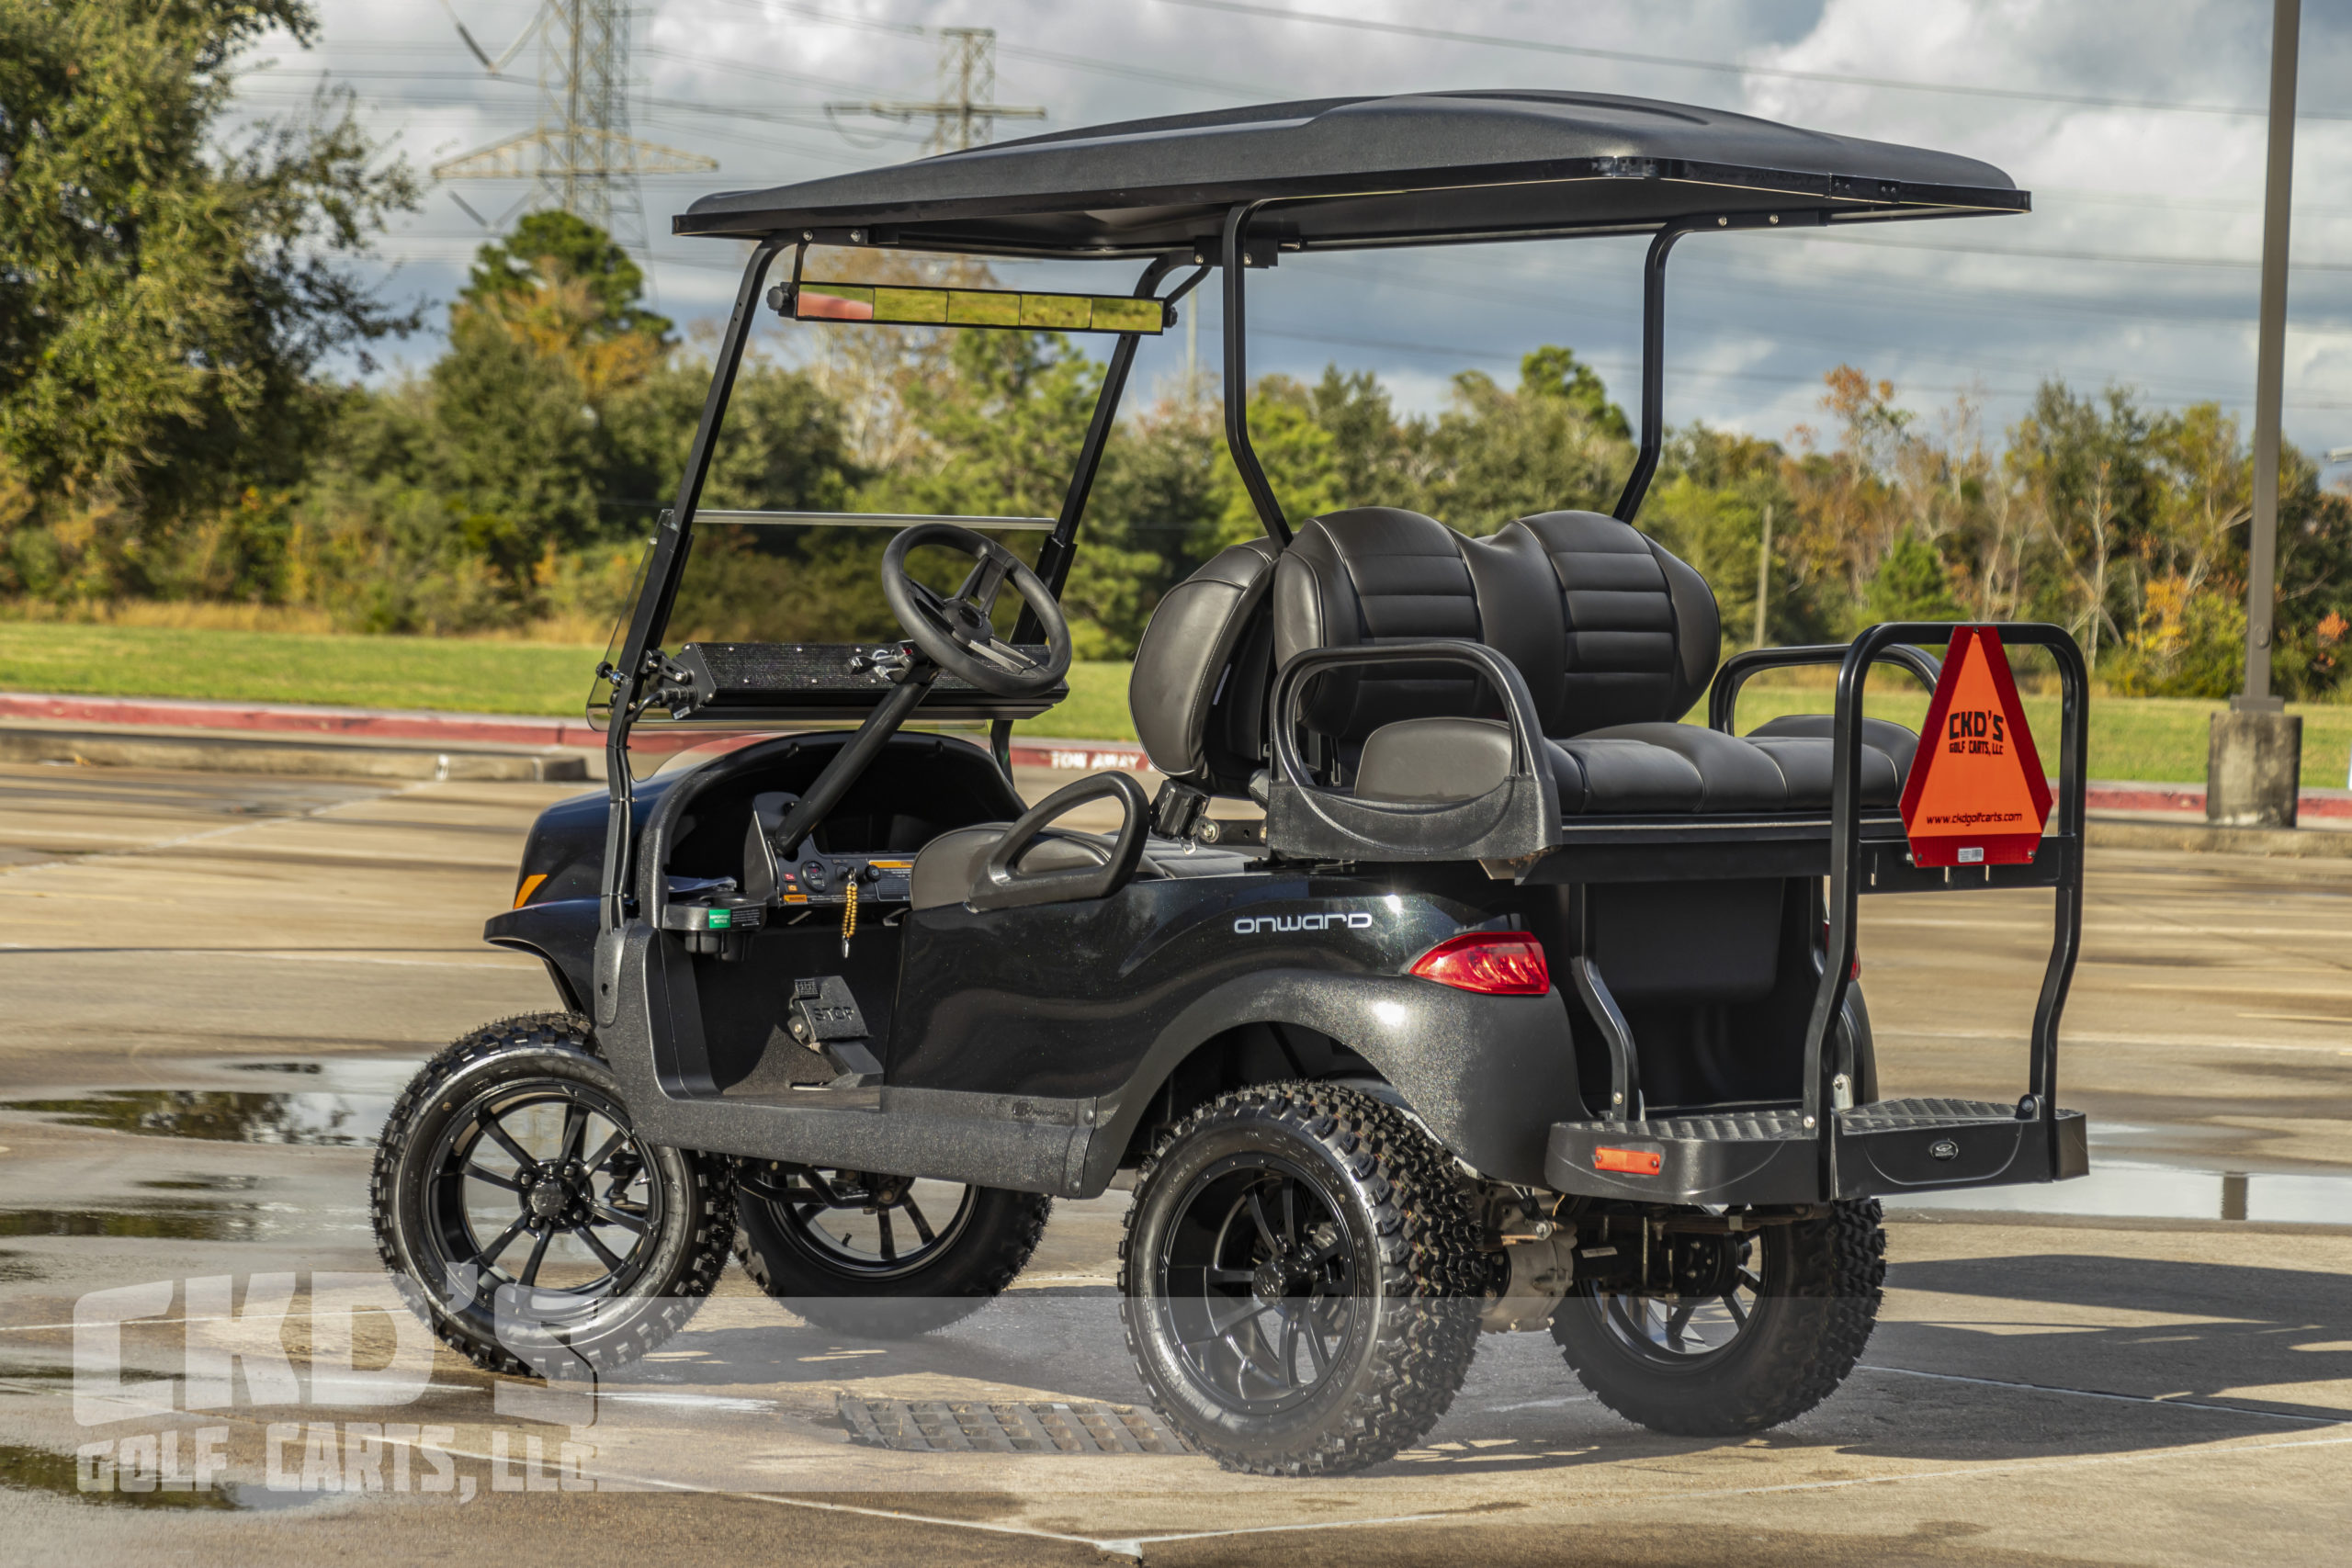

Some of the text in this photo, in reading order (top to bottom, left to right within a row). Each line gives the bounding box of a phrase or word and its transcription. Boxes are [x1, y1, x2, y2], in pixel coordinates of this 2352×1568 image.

[1949, 710, 2004, 742] CKD'S
[1949, 740, 1965, 753] GOLF
[1050, 750, 1087, 769] TOW
[1091, 752, 1140, 771] AWAY
[1926, 812, 2023, 827] www.ckdgolfcarts.com
[813, 1006, 855, 1021] STOP
